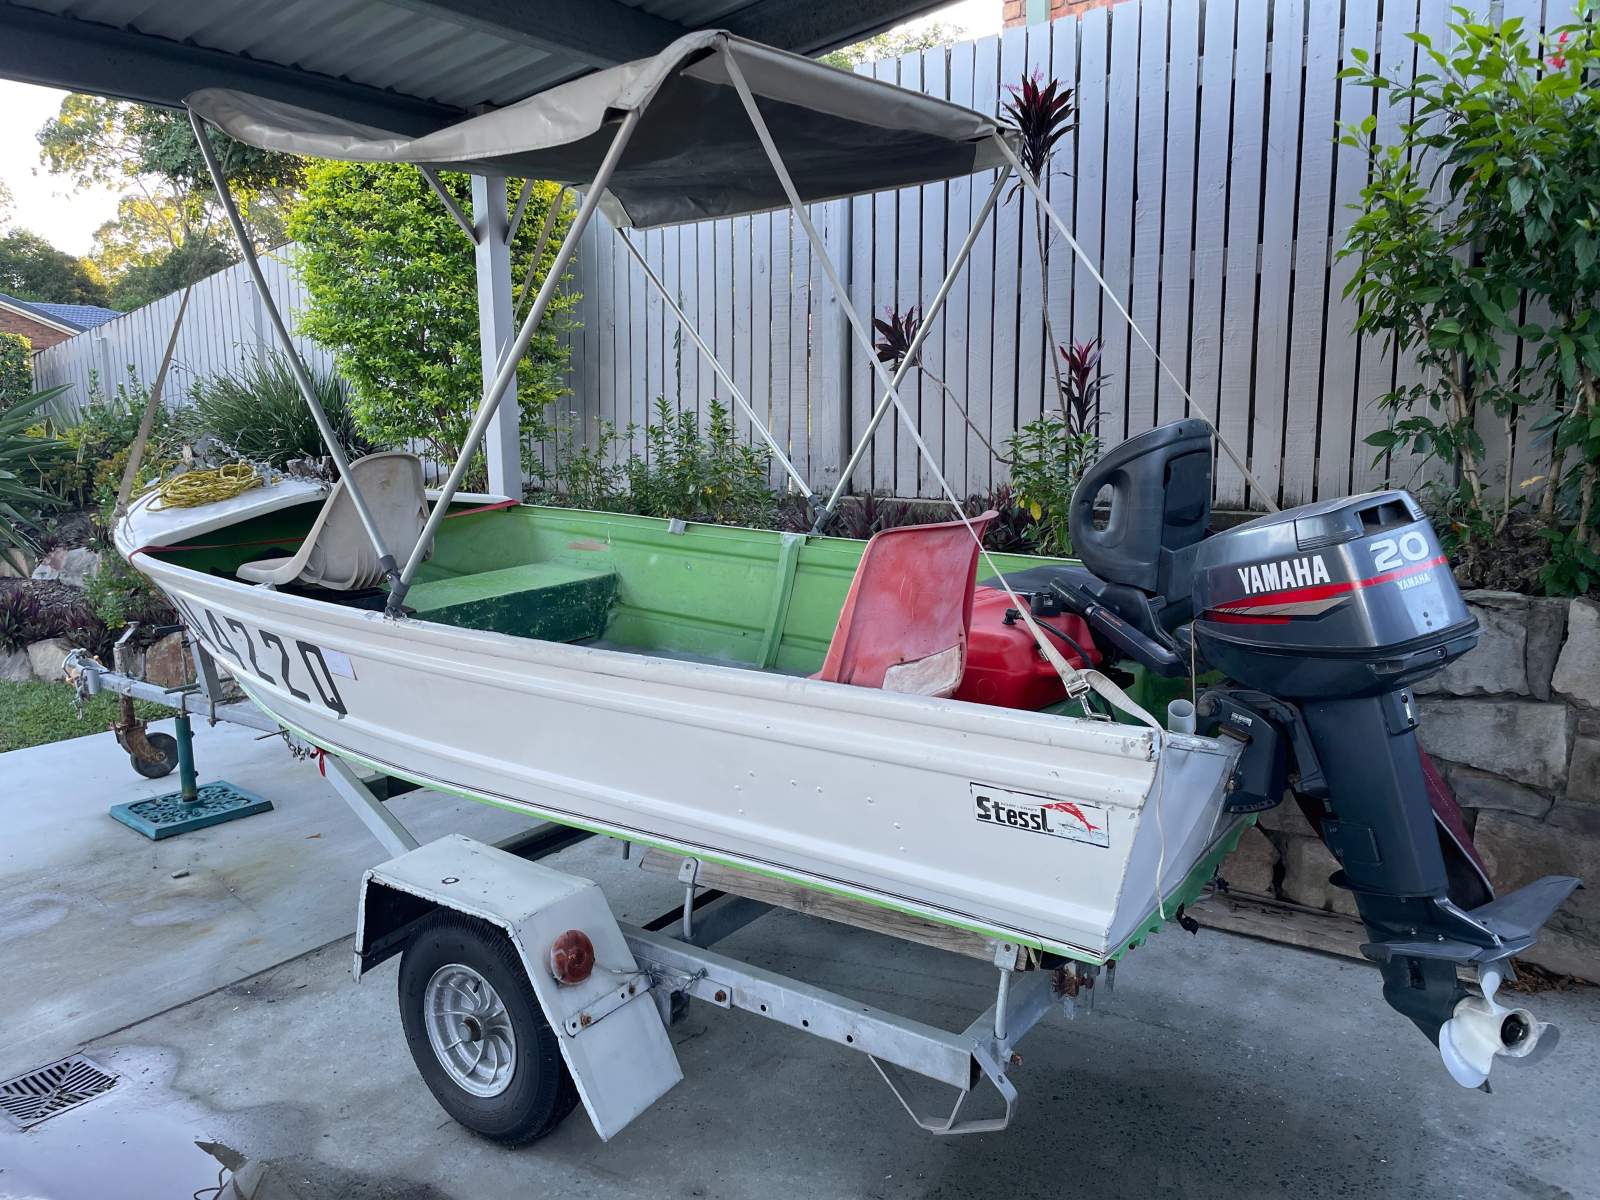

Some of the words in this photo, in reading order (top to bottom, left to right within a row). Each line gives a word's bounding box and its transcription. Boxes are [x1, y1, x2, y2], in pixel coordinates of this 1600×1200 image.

[1370, 531, 1429, 572] 20
[1238, 555, 1331, 594] YAMAHA
[1397, 573, 1432, 591] YAMAHA
